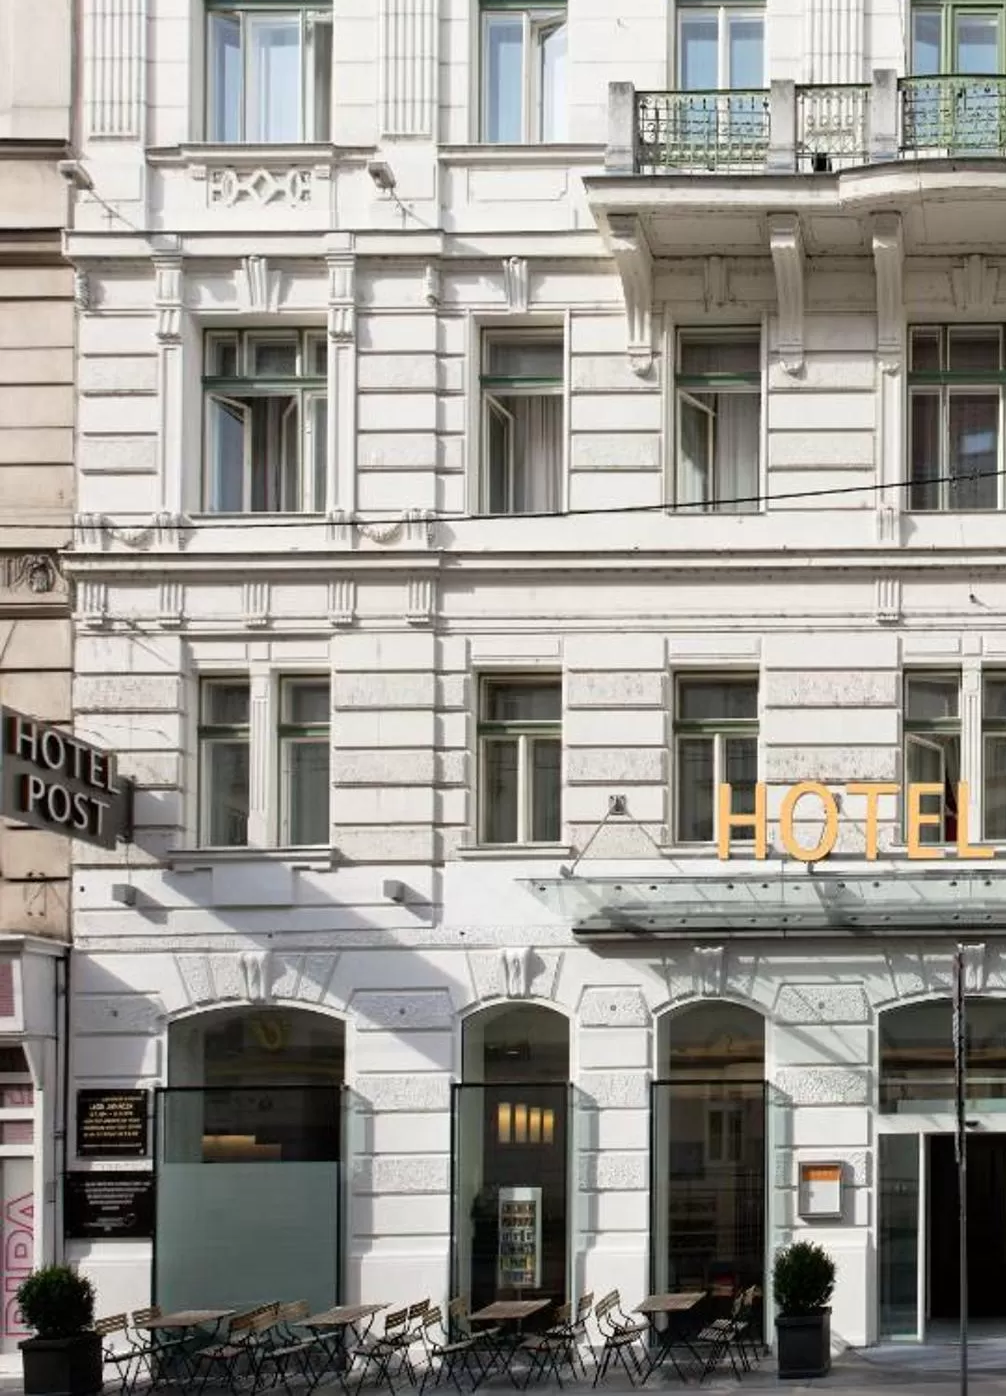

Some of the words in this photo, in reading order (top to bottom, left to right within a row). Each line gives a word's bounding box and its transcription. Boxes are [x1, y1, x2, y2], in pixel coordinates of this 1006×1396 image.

[15, 715, 122, 795] HOTEL
[28, 775, 111, 837] POST
[717, 780, 994, 861] HOTEL
